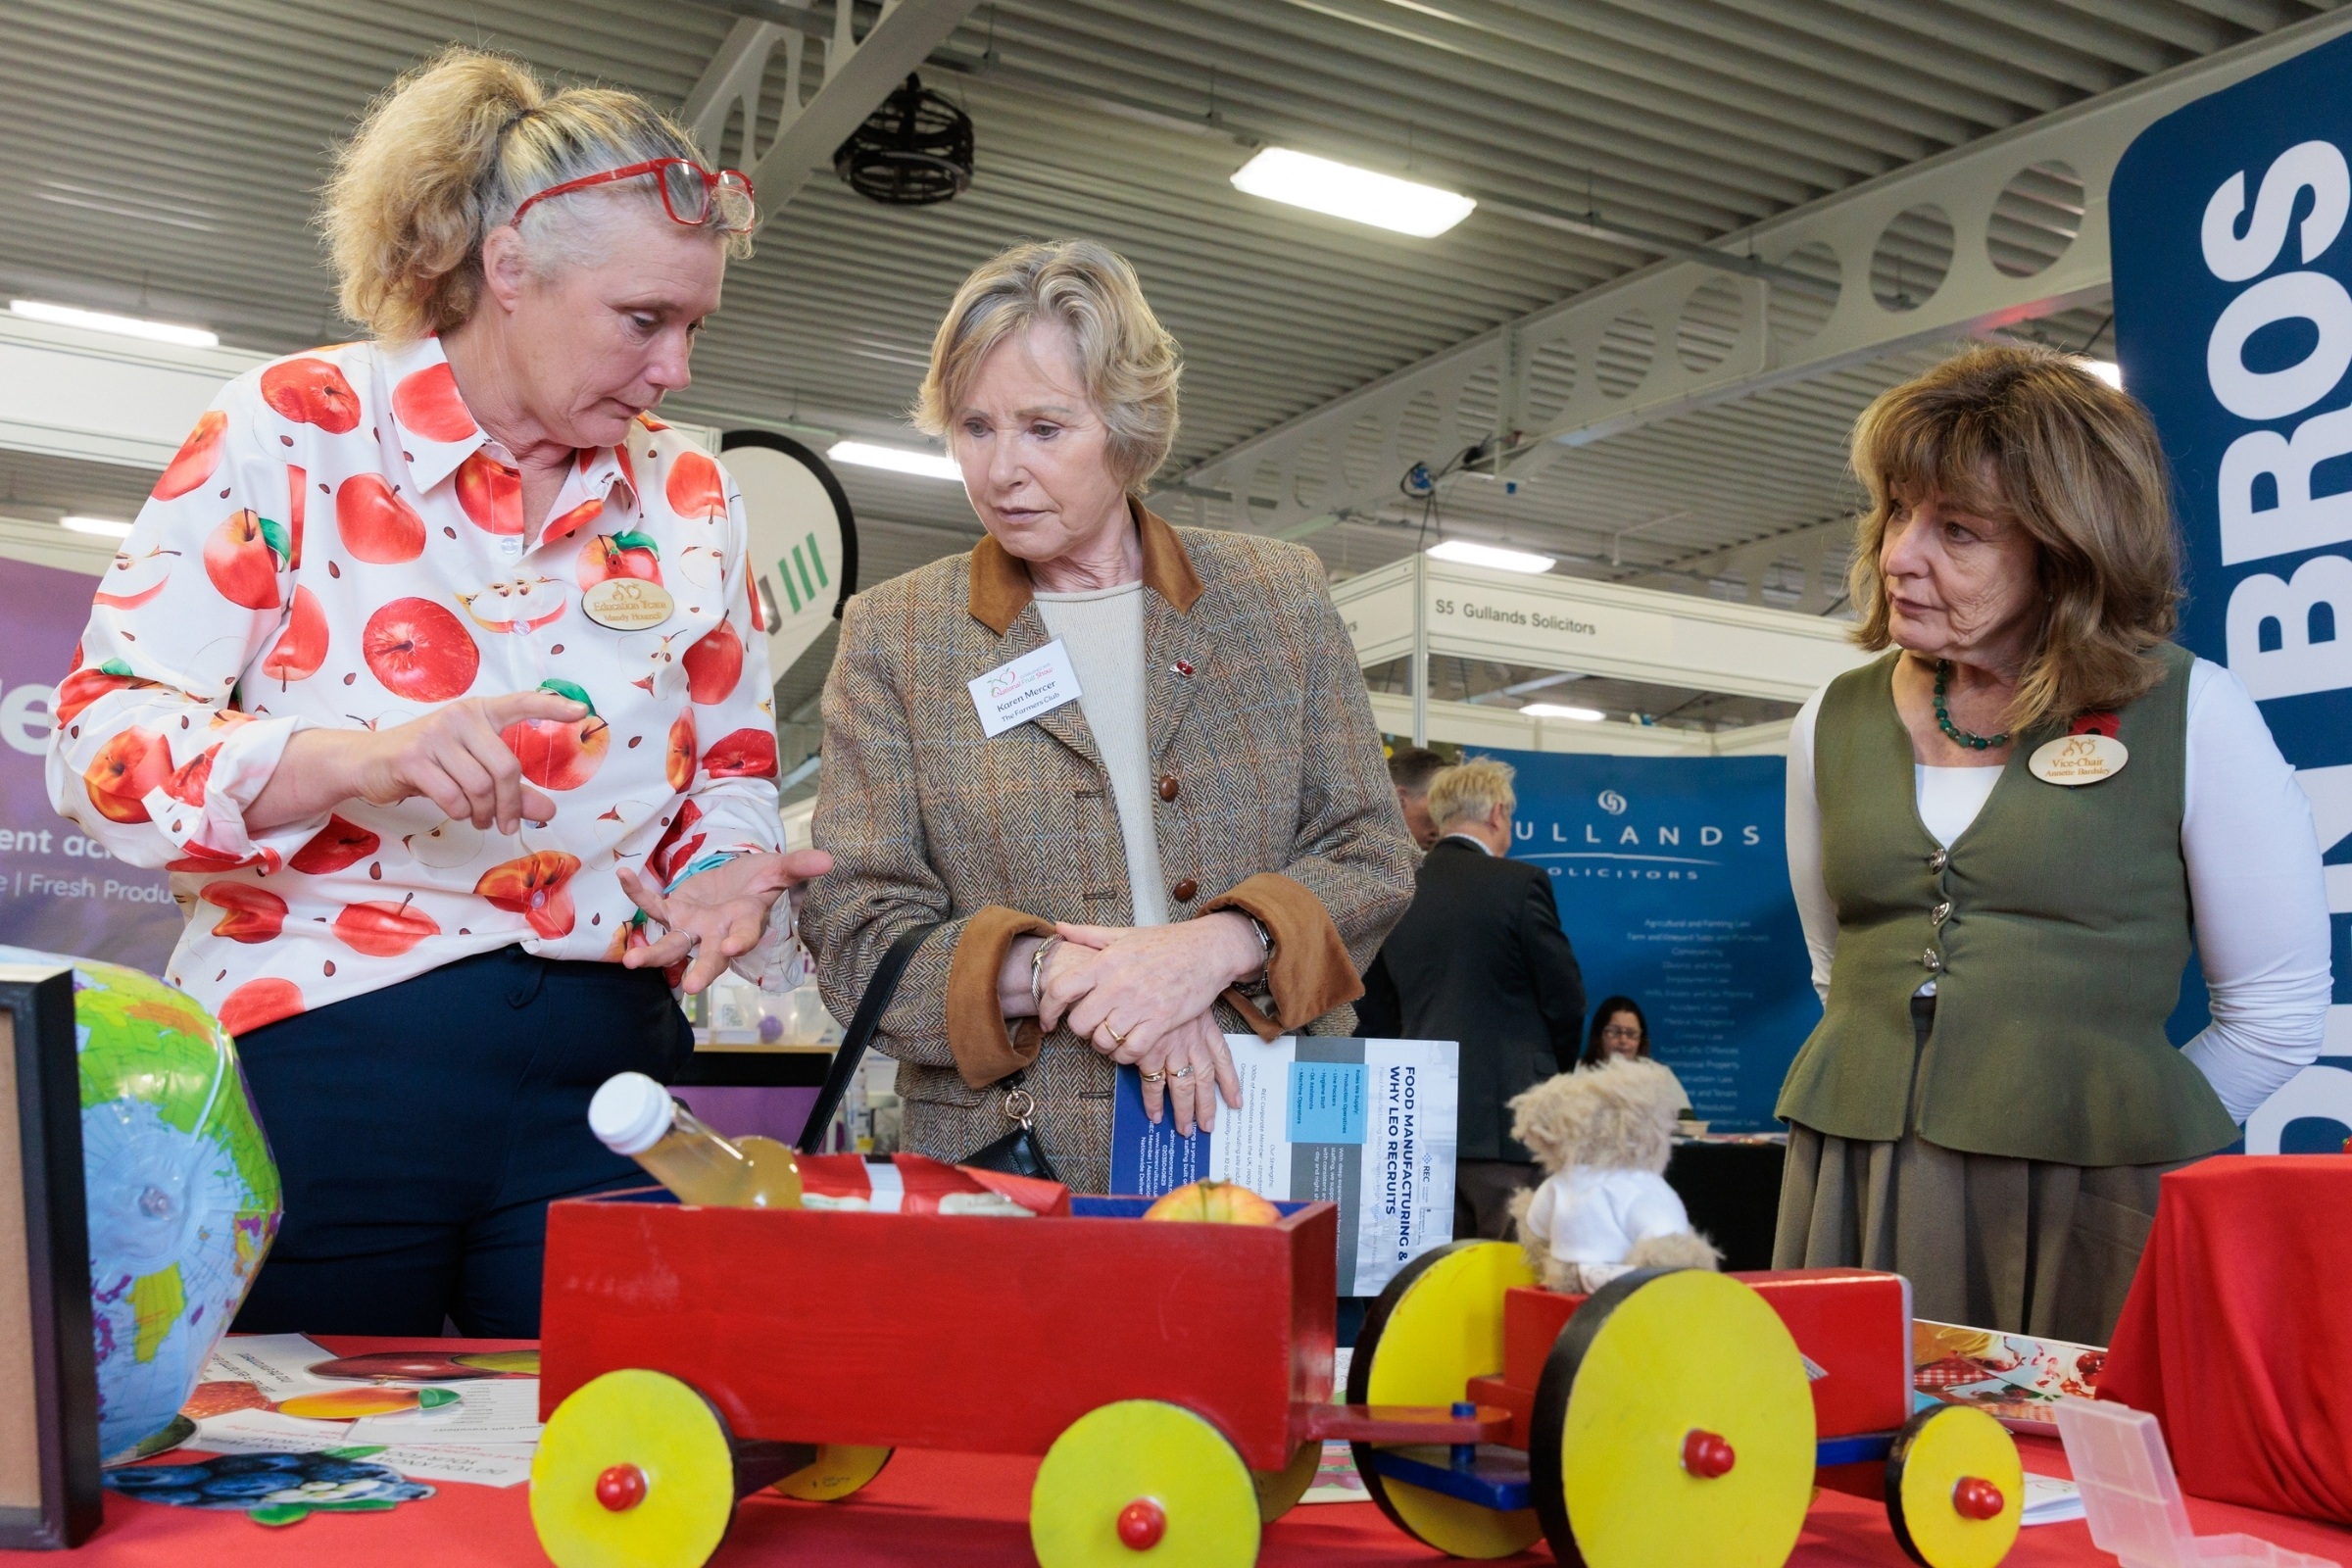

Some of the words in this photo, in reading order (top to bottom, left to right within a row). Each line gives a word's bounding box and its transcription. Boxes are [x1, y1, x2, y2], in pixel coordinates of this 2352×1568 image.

[2201, 139, 2352, 701] BROS
[593, 602, 639, 612] Education
[642, 600, 667, 610] Team
[1436, 599, 1454, 615] S5
[1463, 603, 1527, 625] Gullands
[1532, 612, 1596, 635] Solicitors
[997, 681, 1022, 697] National
[1021, 675, 1036, 685] Fruit
[1035, 667, 1054, 678] Show
[997, 696, 1024, 712] Karen
[1024, 680, 1055, 700] Mercer
[1001, 713, 1015, 722] The
[1014, 701, 1044, 716] Farmers
[1043, 692, 1060, 704] Club
[2052, 758, 2104, 768] Vice-Chair
[2078, 767, 2111, 776] Bardsley
[0, 828, 53, 855] ent
[1514, 820, 1761, 847] ULLANDS
[1546, 866, 1698, 880] OLICITORS
[28, 873, 96, 899] Fresh
[103, 879, 173, 905] Produ
[1309, 1072, 1315, 1082] QA
[1354, 1085, 1360, 1094] We
[1390, 1066, 1400, 1103] WHY
[1403, 1066, 1416, 1110] FOOD
[1375, 1085, 1385, 1135] Manufacturing
[1389, 1106, 1399, 1137] LEO
[1330, 1171, 1335, 1180] we
[1386, 1141, 1398, 1215] RECRUITS
[1398, 1114, 1415, 1248] MANUFACTURING
[1398, 1251, 1407, 1261] &
